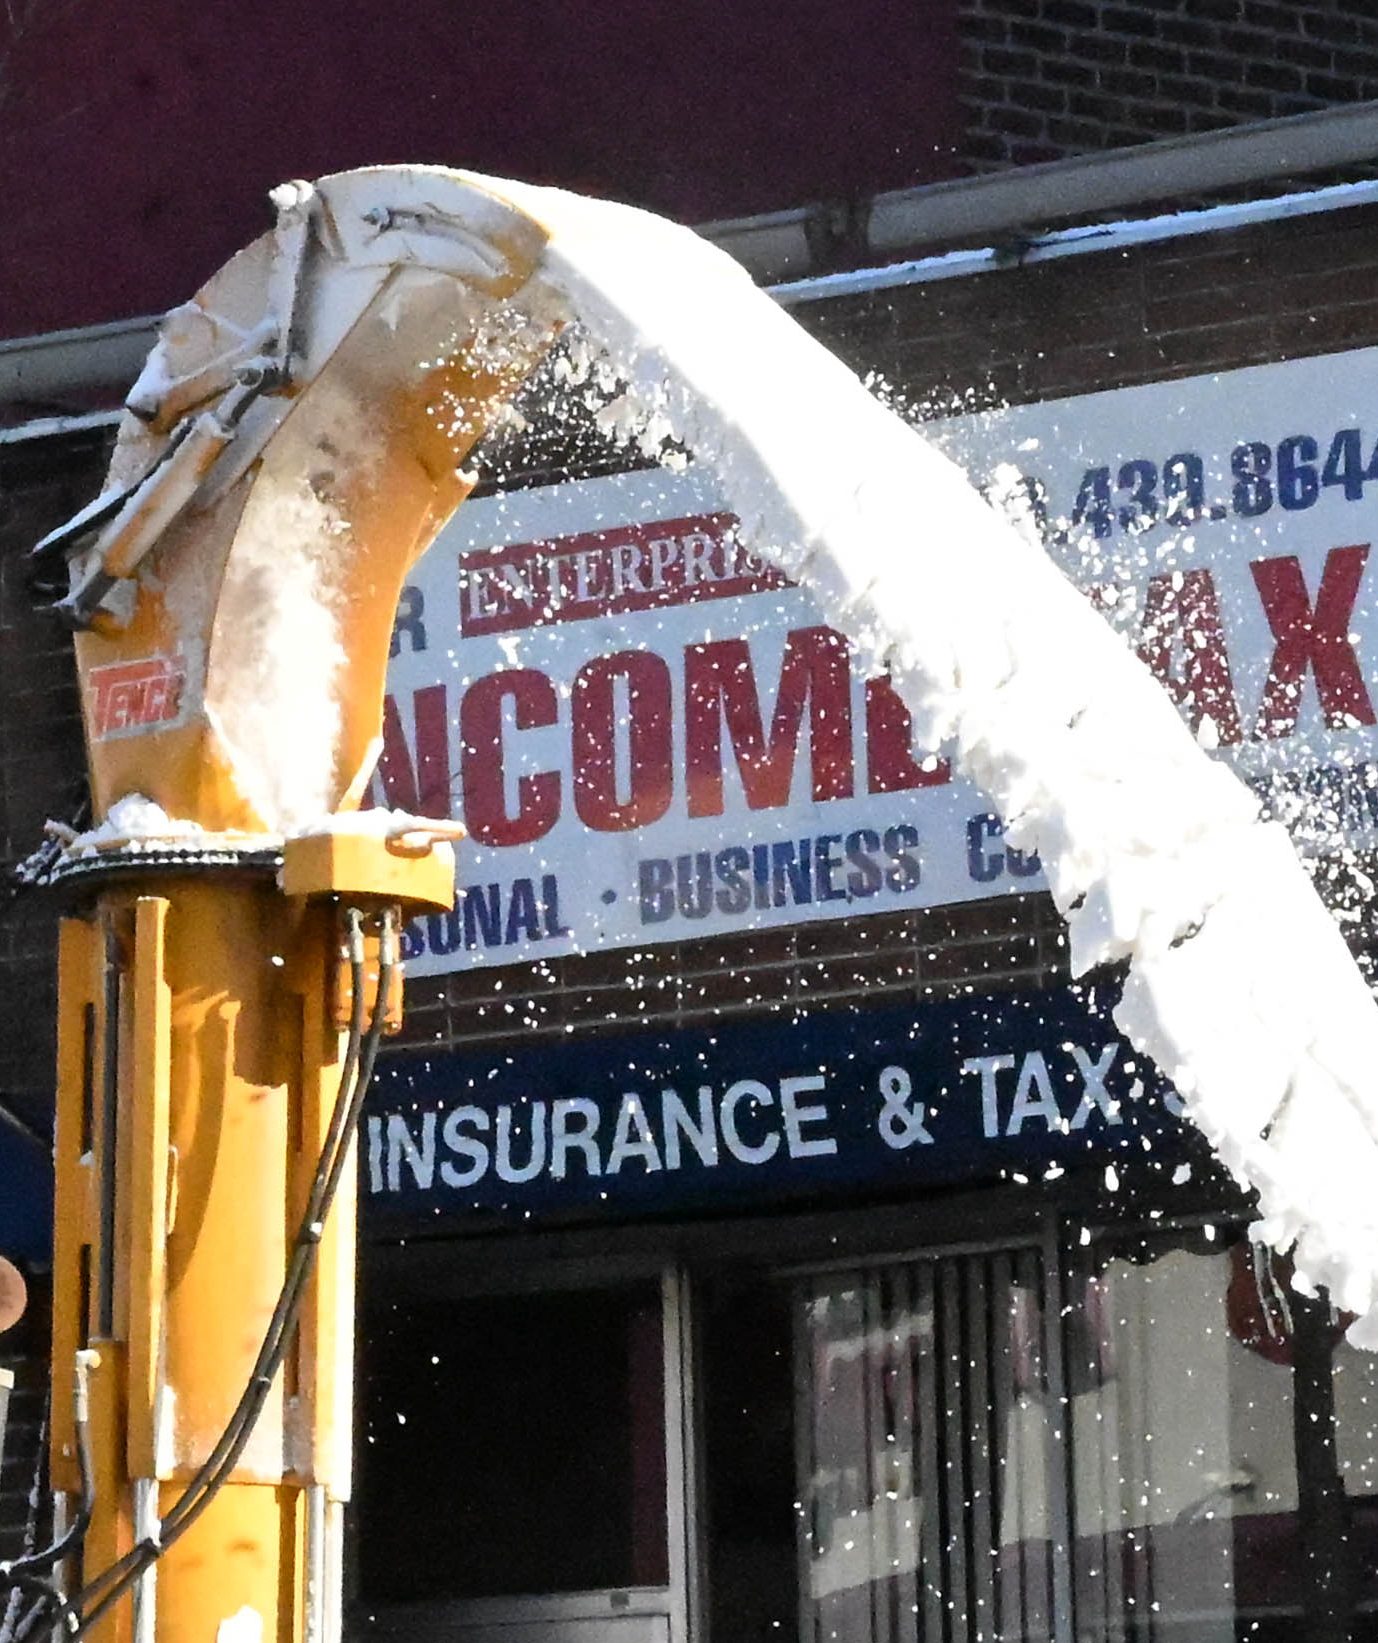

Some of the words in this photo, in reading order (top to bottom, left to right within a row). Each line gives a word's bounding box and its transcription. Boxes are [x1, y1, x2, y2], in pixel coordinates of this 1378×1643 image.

[365, 624, 951, 848] NCOM
[1093, 543, 1377, 748] AX
[638, 825, 922, 926] BUSINESS
[367, 1076, 838, 1195] INSURANCE
[878, 1064, 934, 1151] &
[963, 1043, 1124, 1140] TAX
